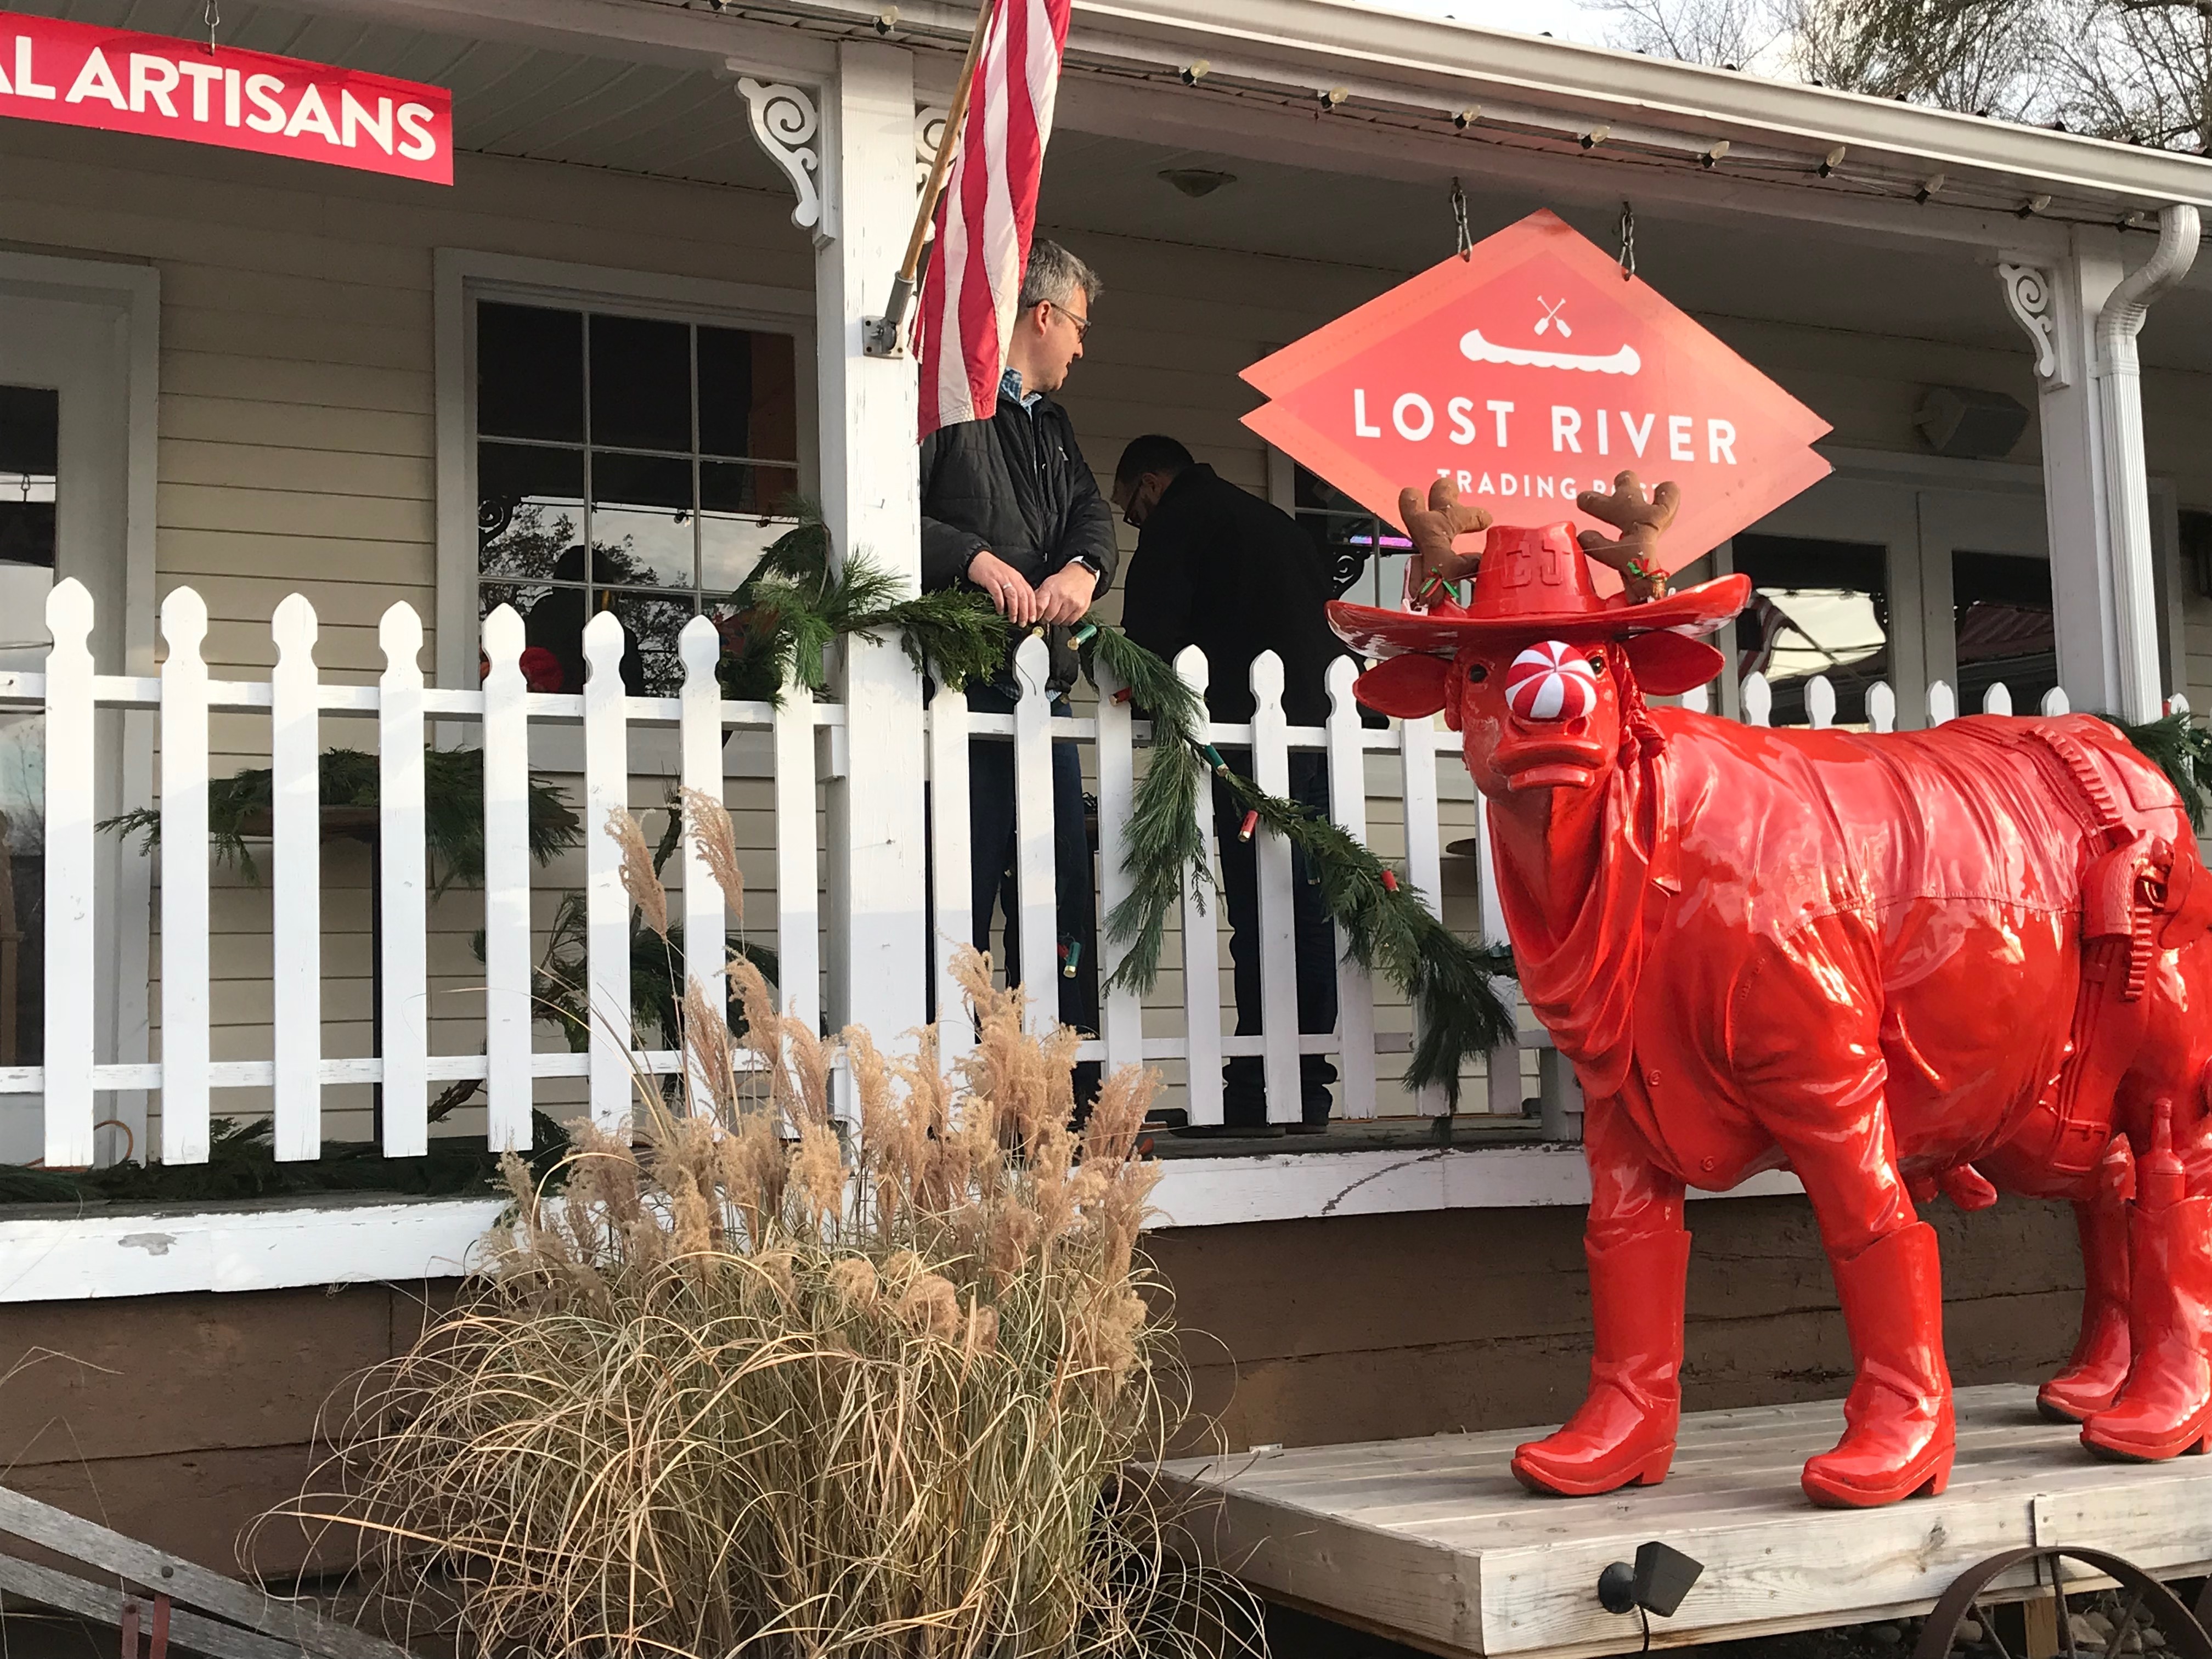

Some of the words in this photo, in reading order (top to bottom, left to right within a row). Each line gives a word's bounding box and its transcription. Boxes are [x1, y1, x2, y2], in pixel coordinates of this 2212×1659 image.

[0, 35, 56, 100] L
[65, 46, 437, 161] ARTISANS
[1353, 388, 1515, 448] LOST
[1550, 405, 1738, 466] RIVER
